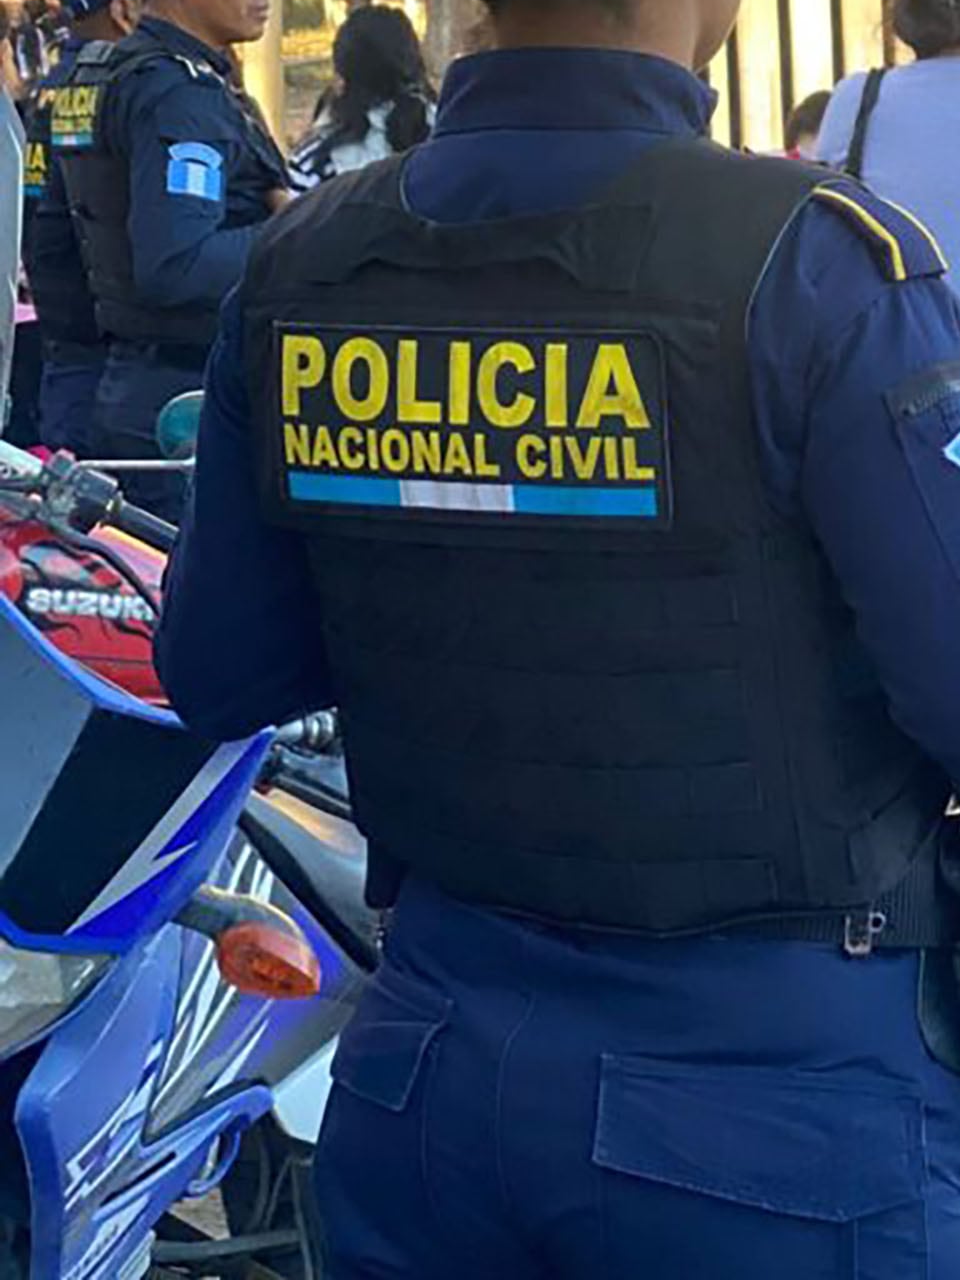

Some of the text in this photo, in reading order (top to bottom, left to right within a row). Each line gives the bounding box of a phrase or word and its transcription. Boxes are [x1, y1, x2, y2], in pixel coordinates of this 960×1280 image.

[281, 334, 651, 429] POLICIA
[284, 424, 656, 480] NACIONAL CIVIL
[26, 588, 154, 621] SUZUK
